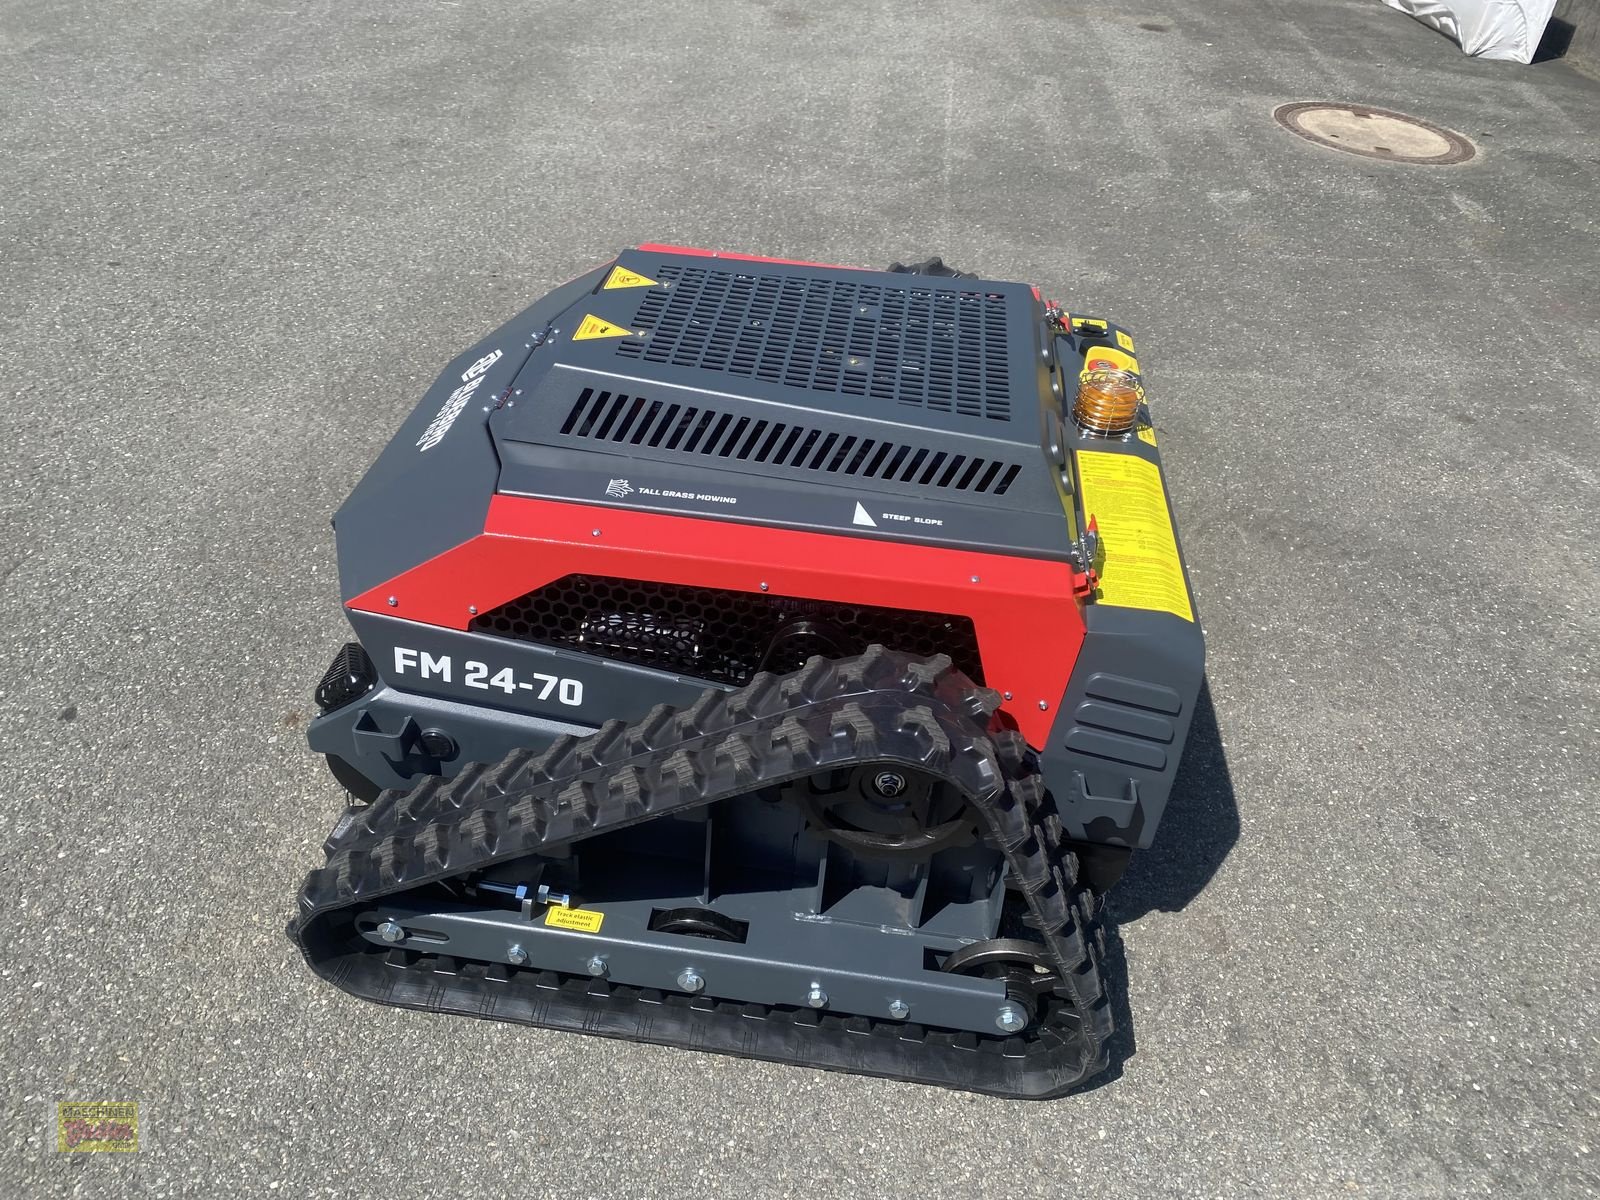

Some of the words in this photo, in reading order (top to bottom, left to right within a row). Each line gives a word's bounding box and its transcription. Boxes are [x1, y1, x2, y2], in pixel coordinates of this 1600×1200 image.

[420, 374, 486, 452] BLUEBIRD
[639, 487, 661, 496] TALL
[662, 490, 695, 500] GRASS
[696, 494, 737, 504] MOWING
[882, 513, 912, 522] STEEP
[914, 517, 944, 526] SLOPE
[393, 646, 452, 683] FM
[464, 660, 584, 707] 24-70
[556, 918, 592, 928] adjustment
[557, 911, 574, 919] Track
[574, 913, 595, 922] elastic
